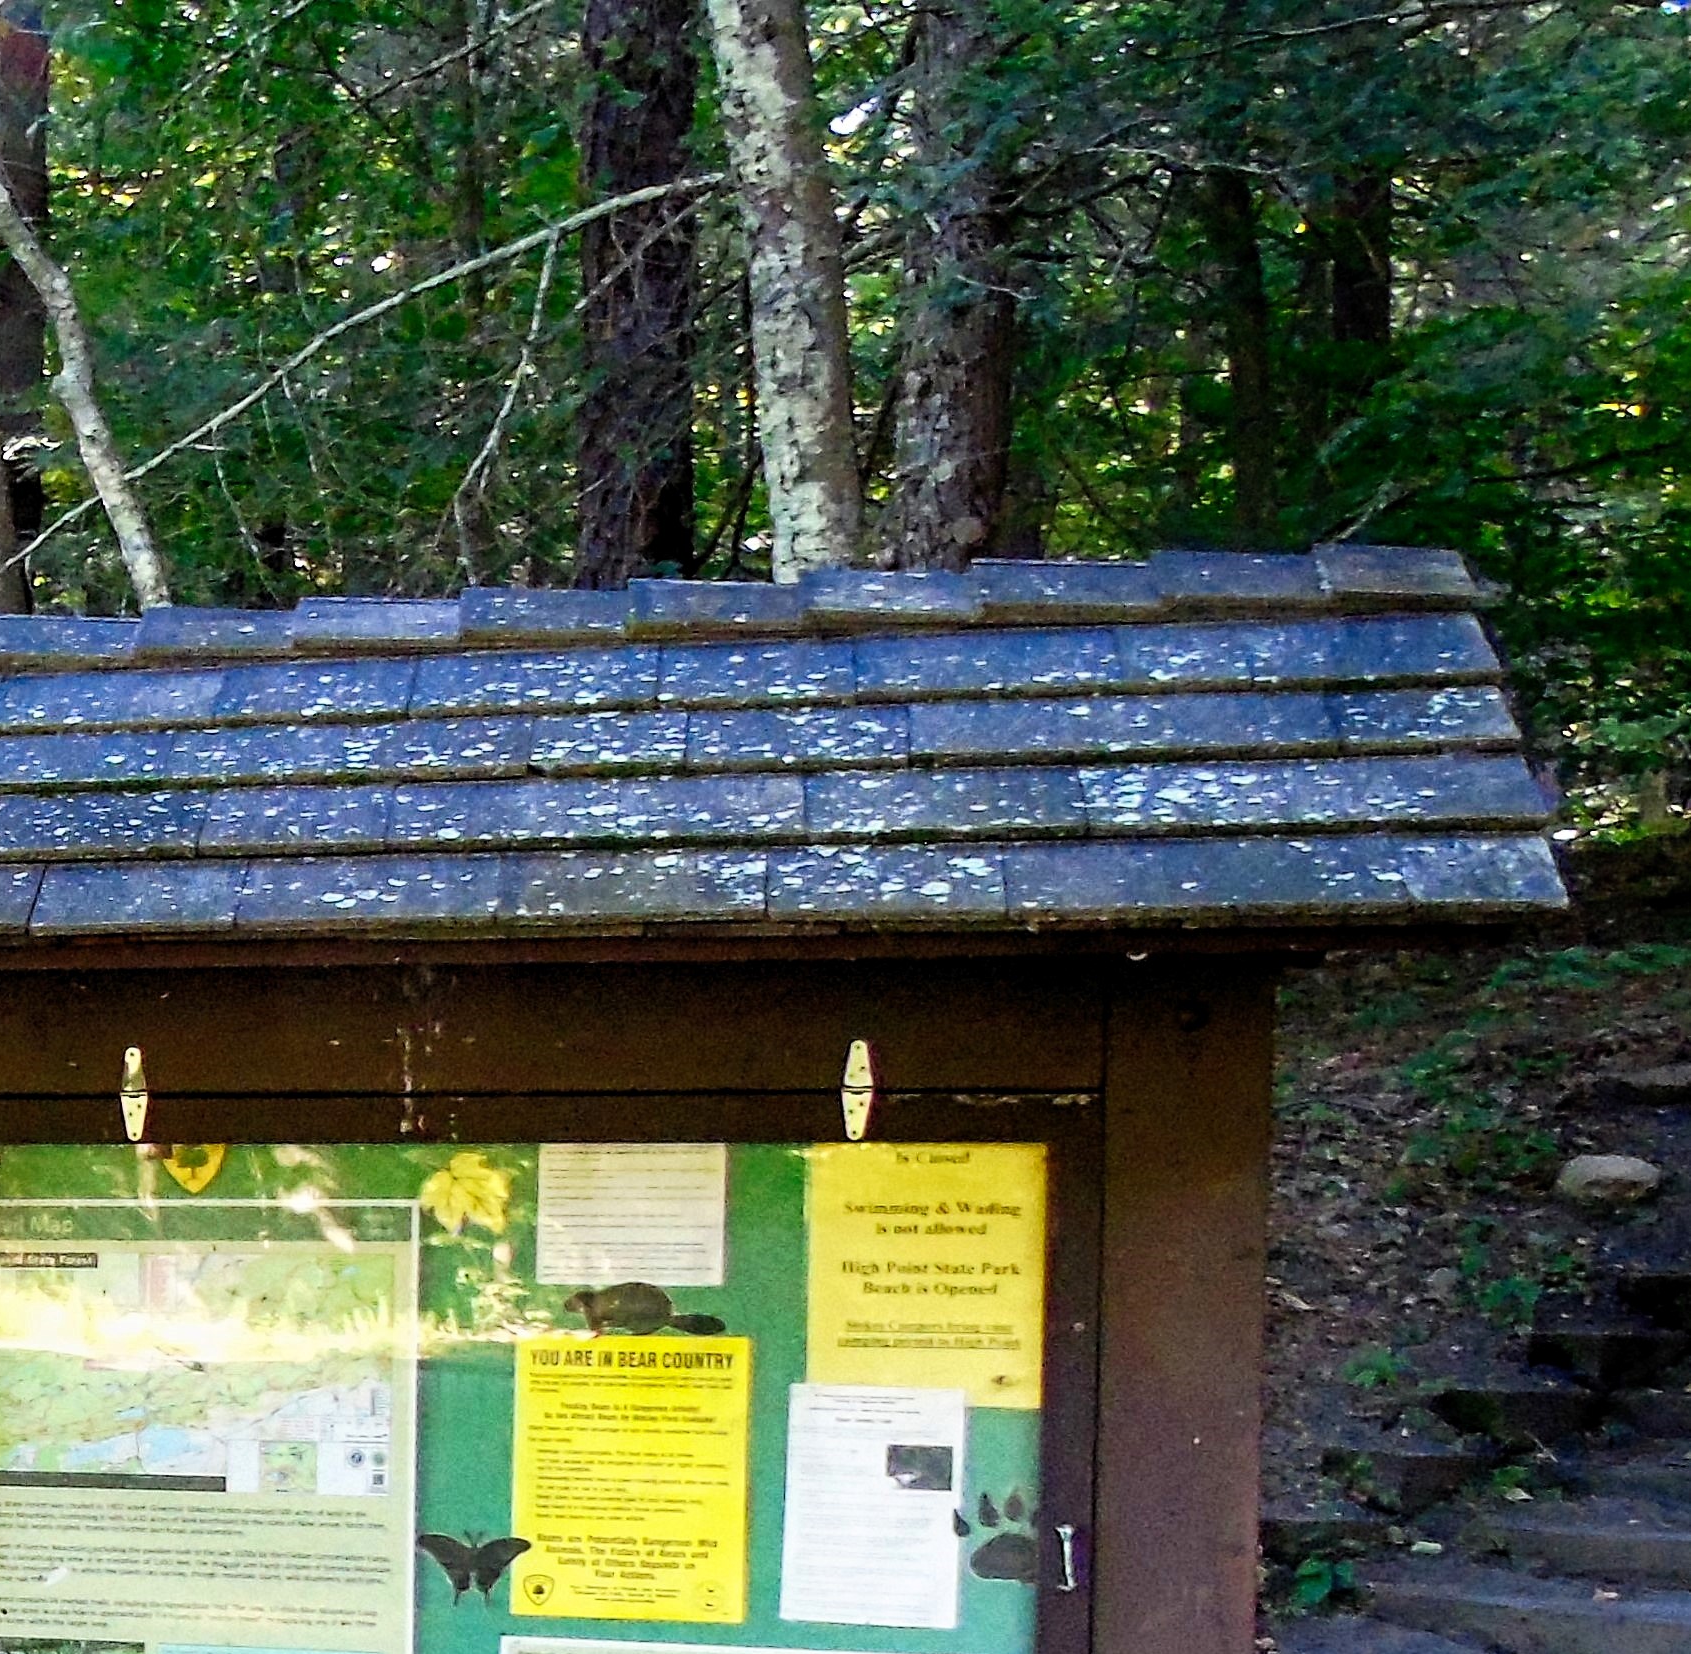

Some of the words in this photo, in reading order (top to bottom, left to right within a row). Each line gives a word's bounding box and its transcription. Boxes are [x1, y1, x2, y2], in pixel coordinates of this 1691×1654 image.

[843, 1201, 930, 1217] Swimming
[935, 1202, 950, 1215] &
[956, 1202, 1023, 1217] Wading
[893, 1223, 918, 1235] not
[925, 1223, 988, 1235] allowed
[841, 1260, 880, 1276] High
[887, 1261, 928, 1275] Point
[933, 1262, 976, 1275] State
[980, 1262, 1021, 1276] Park
[862, 1281, 910, 1295] Beach
[933, 1282, 998, 1297] Opened
[530, 1350, 559, 1367] YOU
[564, 1350, 593, 1367] ARE
[597, 1350, 613, 1368] IN
[617, 1351, 657, 1369] BEAR
[662, 1352, 734, 1370] COUNTRY
